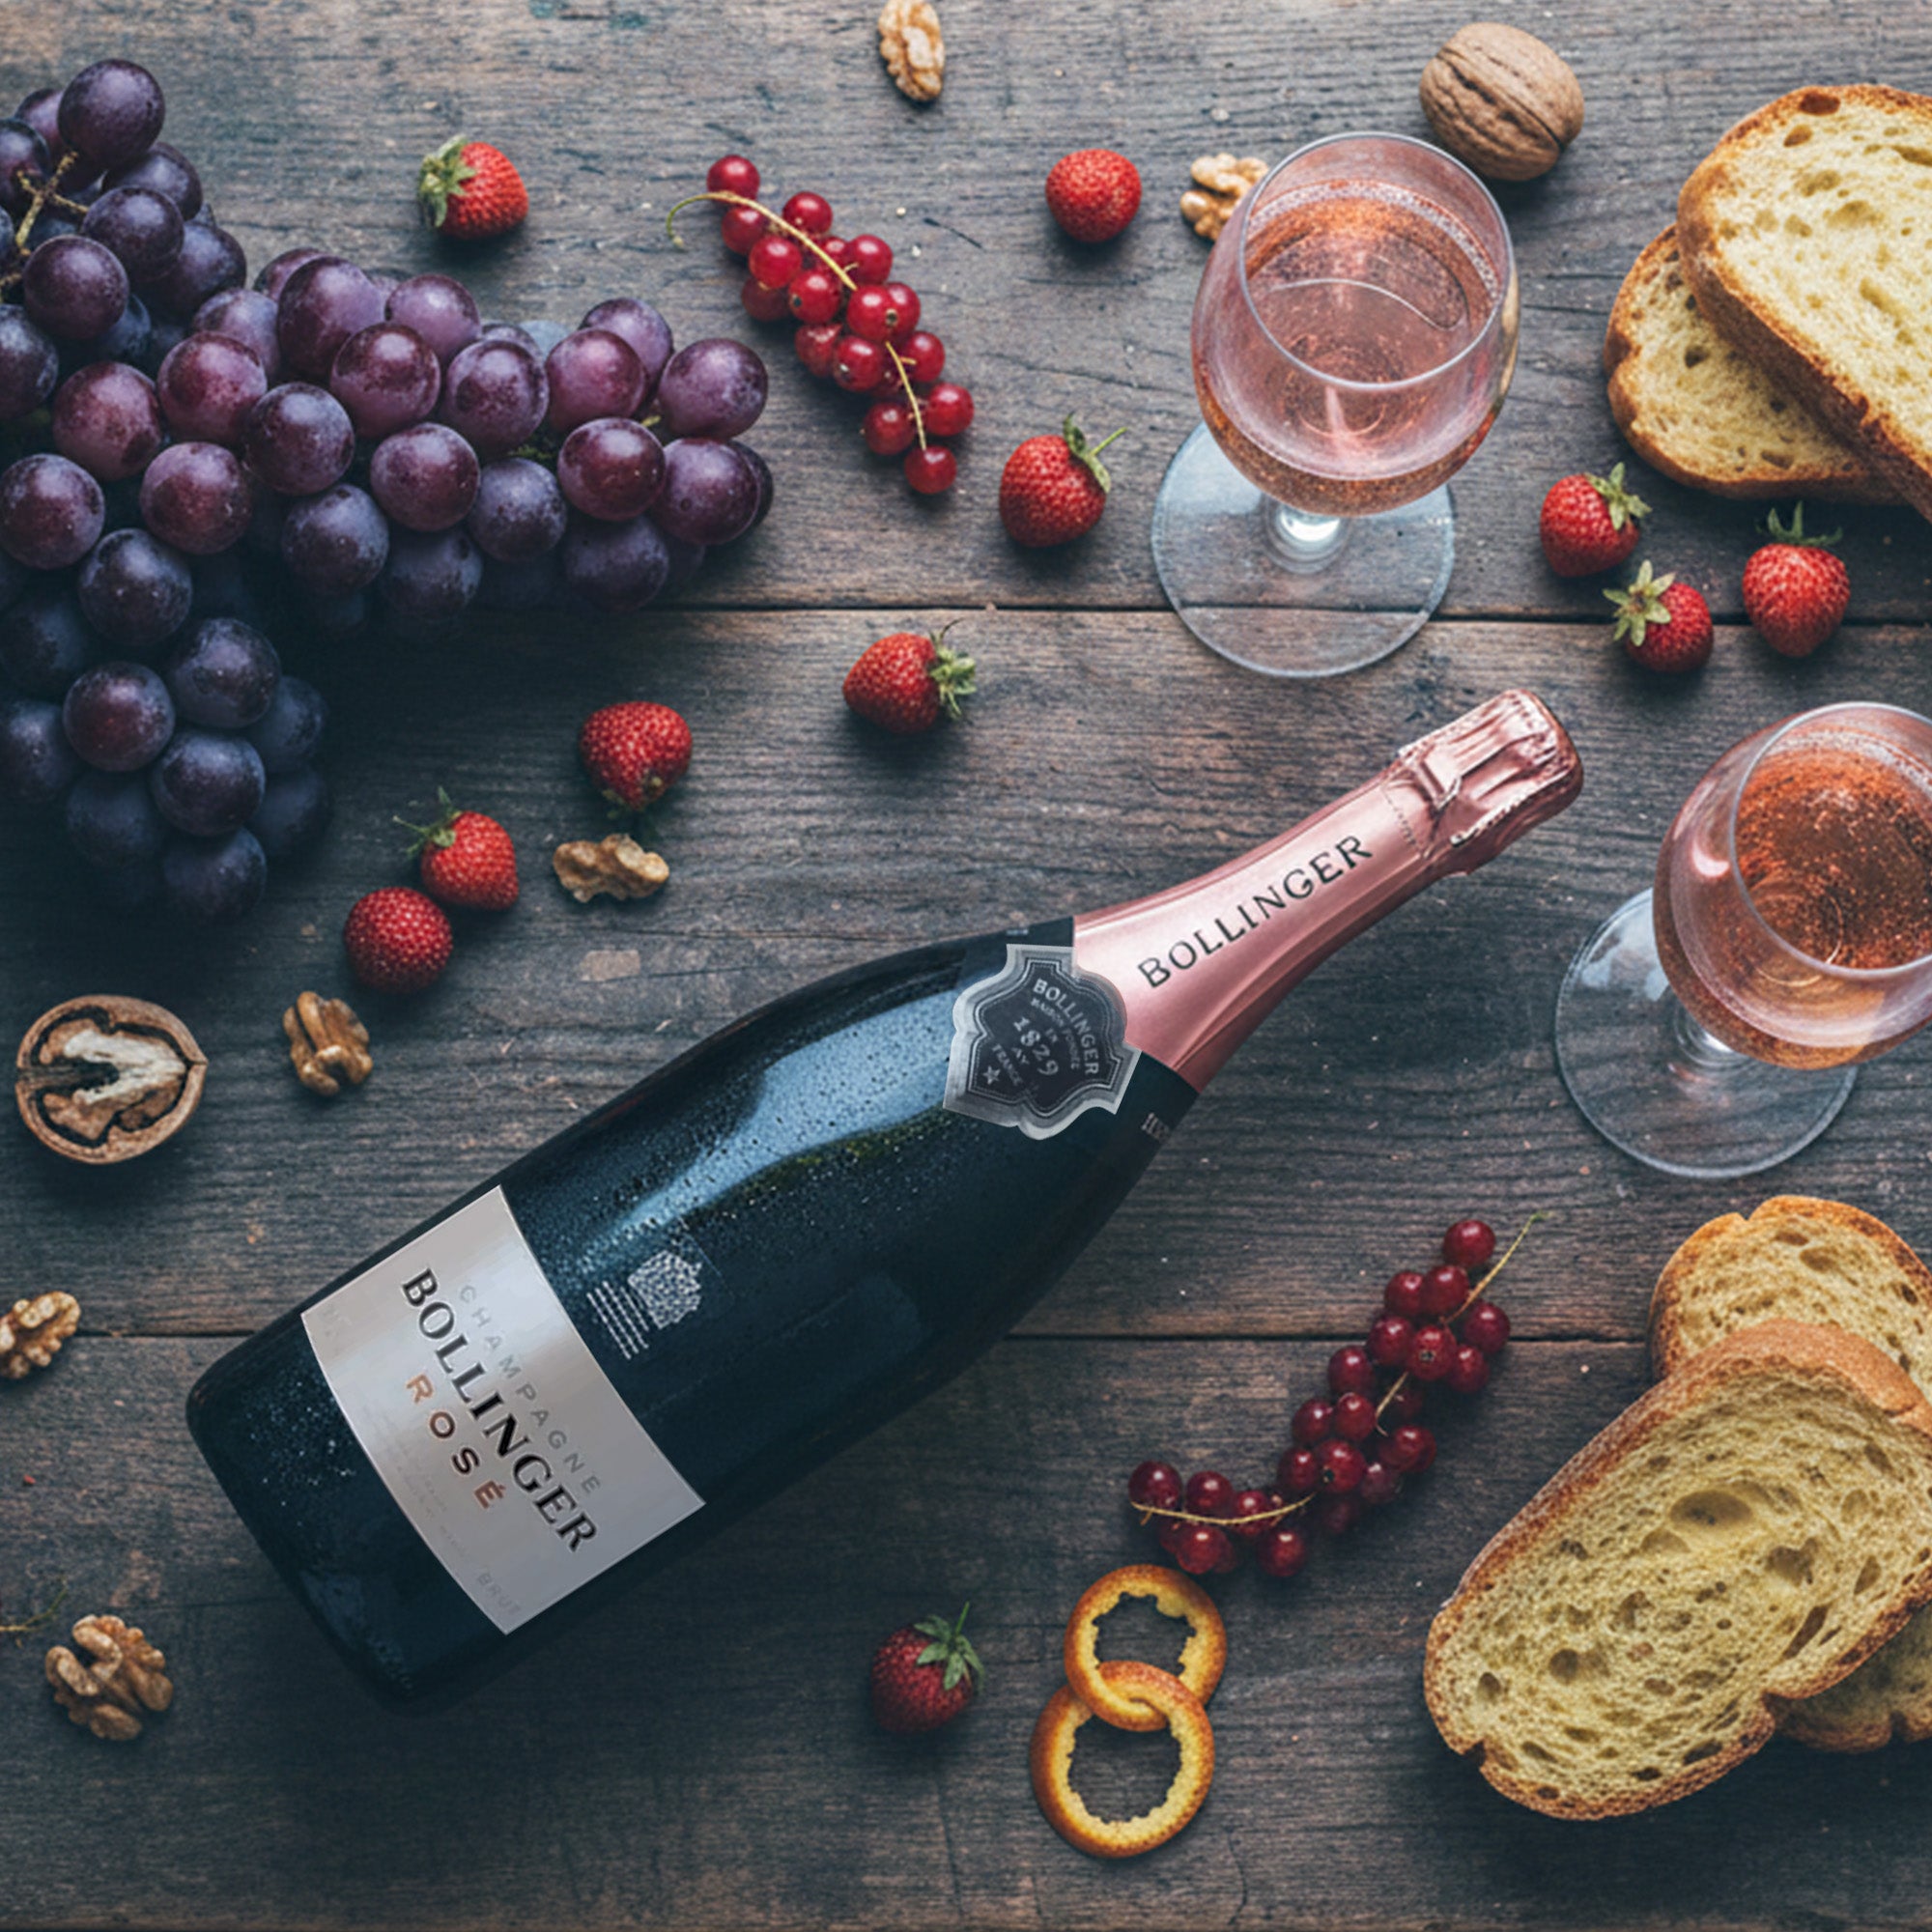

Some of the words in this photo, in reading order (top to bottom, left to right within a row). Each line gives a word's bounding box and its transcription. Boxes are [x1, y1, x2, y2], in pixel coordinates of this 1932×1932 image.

[1137, 836, 1373, 987] BOLLINGER
[1013, 1016, 1059, 1075] 1829
[1033, 978, 1099, 1075] BOLLINGER
[403, 1268, 597, 1552] BOLLINGER
[406, 1374, 505, 1509] ROSÉ
[460, 1285, 600, 1493] CHAMPAGNE
